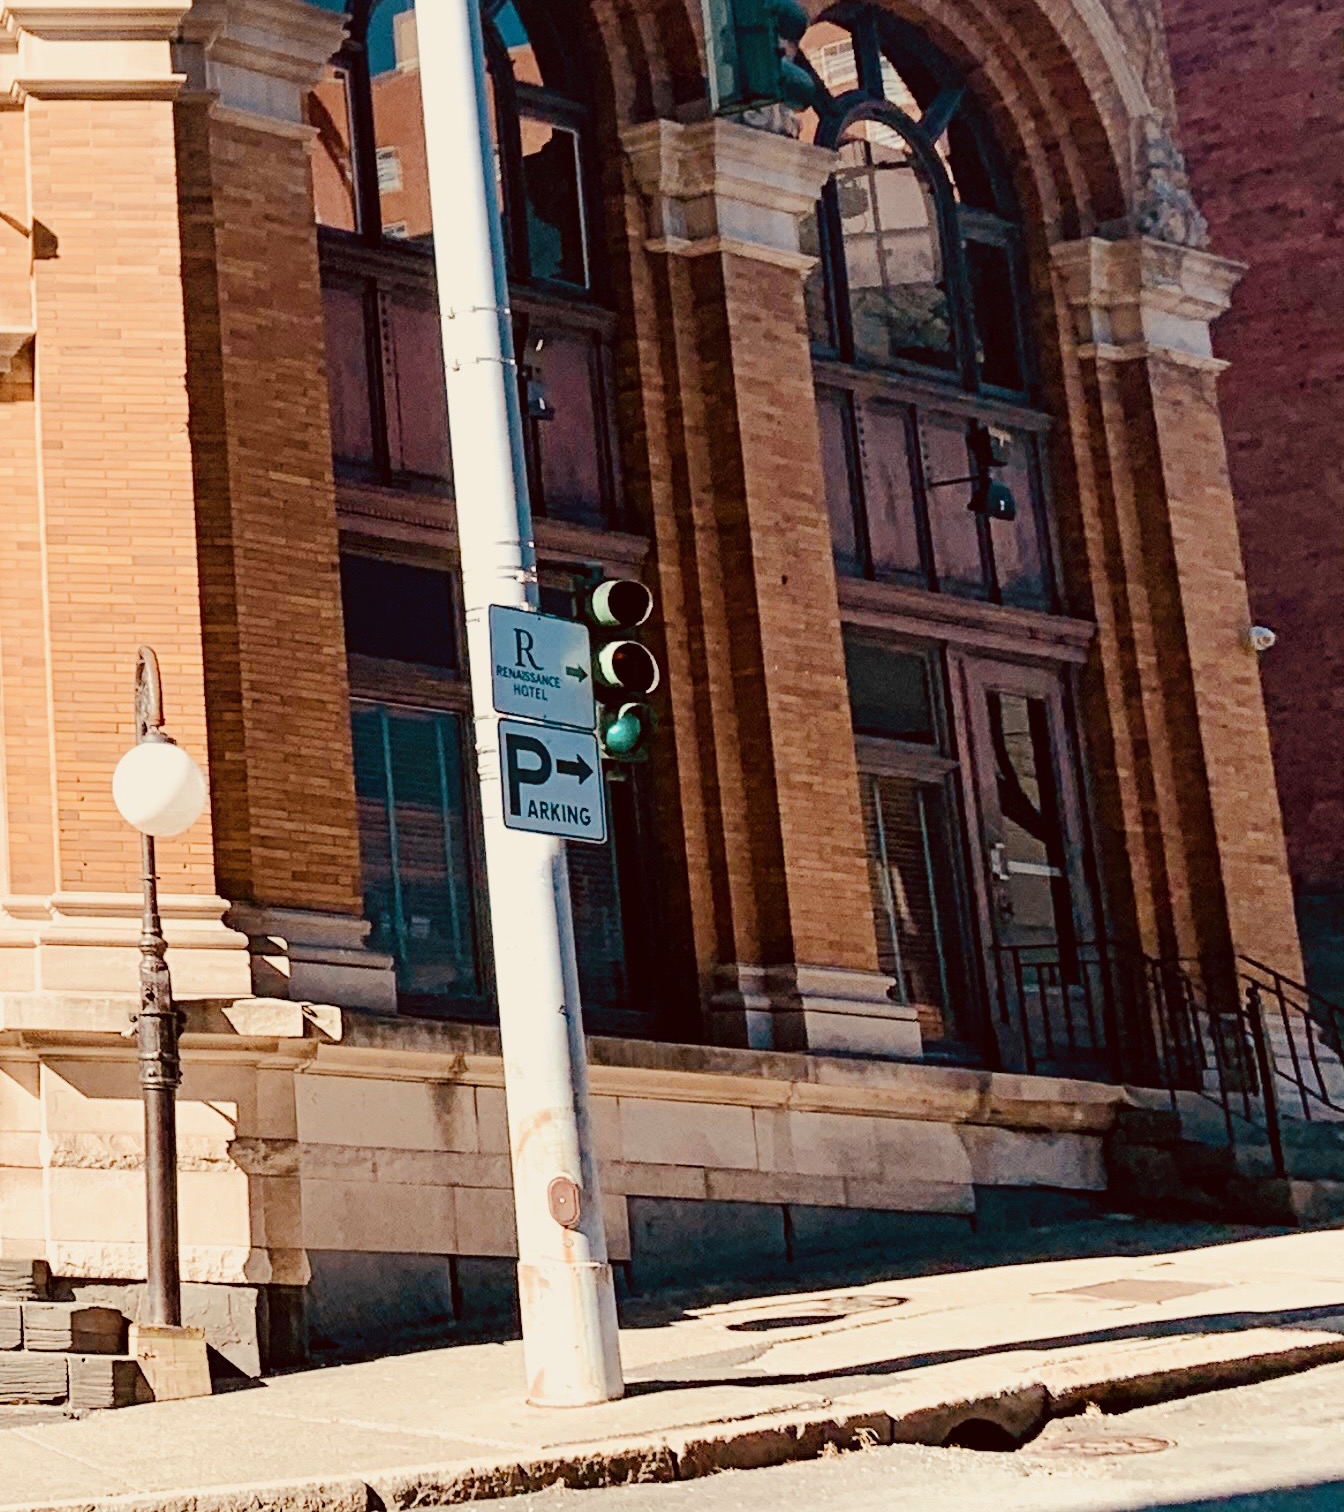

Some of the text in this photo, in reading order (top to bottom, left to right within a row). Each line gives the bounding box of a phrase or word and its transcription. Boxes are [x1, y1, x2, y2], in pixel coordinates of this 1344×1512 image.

[513, 627, 544, 671] R
[496, 664, 561, 689] RENAISSANCE
[513, 684, 548, 702] HOTEL
